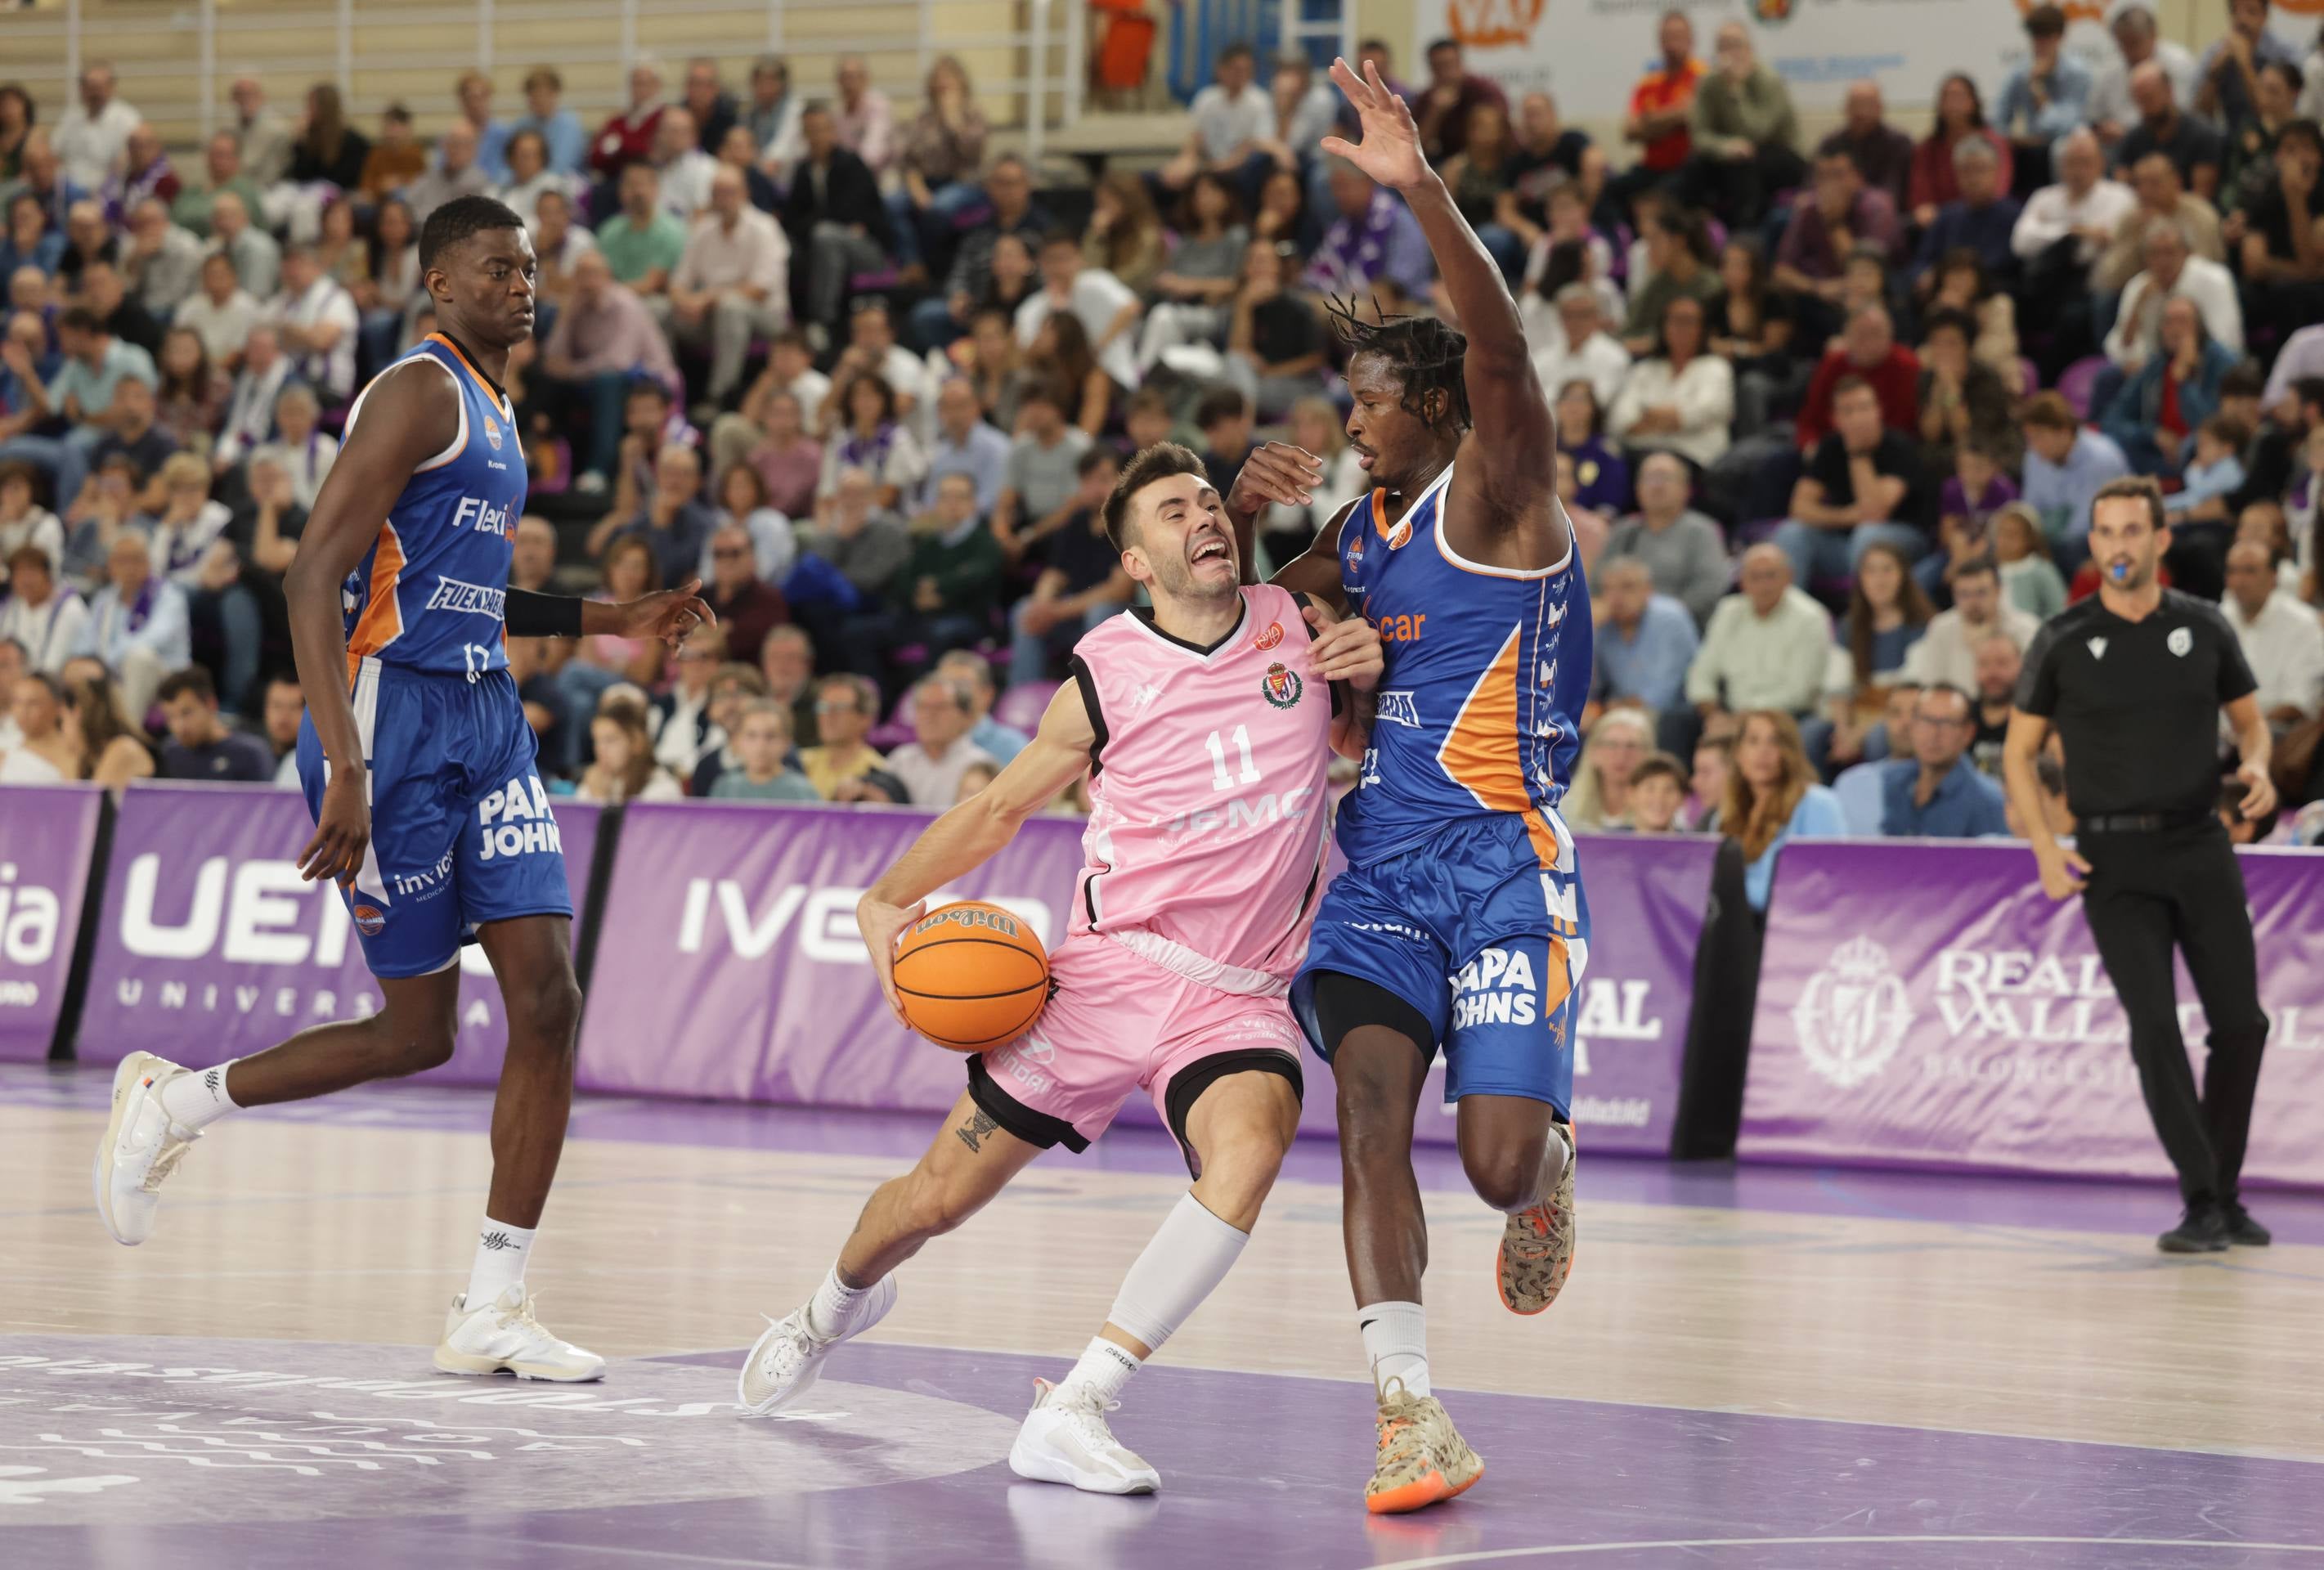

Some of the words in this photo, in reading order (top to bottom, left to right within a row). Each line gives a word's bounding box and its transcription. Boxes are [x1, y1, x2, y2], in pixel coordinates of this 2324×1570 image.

[452, 496, 507, 536] Flexi
[1205, 724, 1261, 792] 11
[479, 775, 558, 825] PAP
[480, 823, 563, 860] JOHN
[916, 908, 1019, 940] Wilson
[1936, 950, 2120, 998] REAL
[1452, 991, 1537, 1032] OHNS
